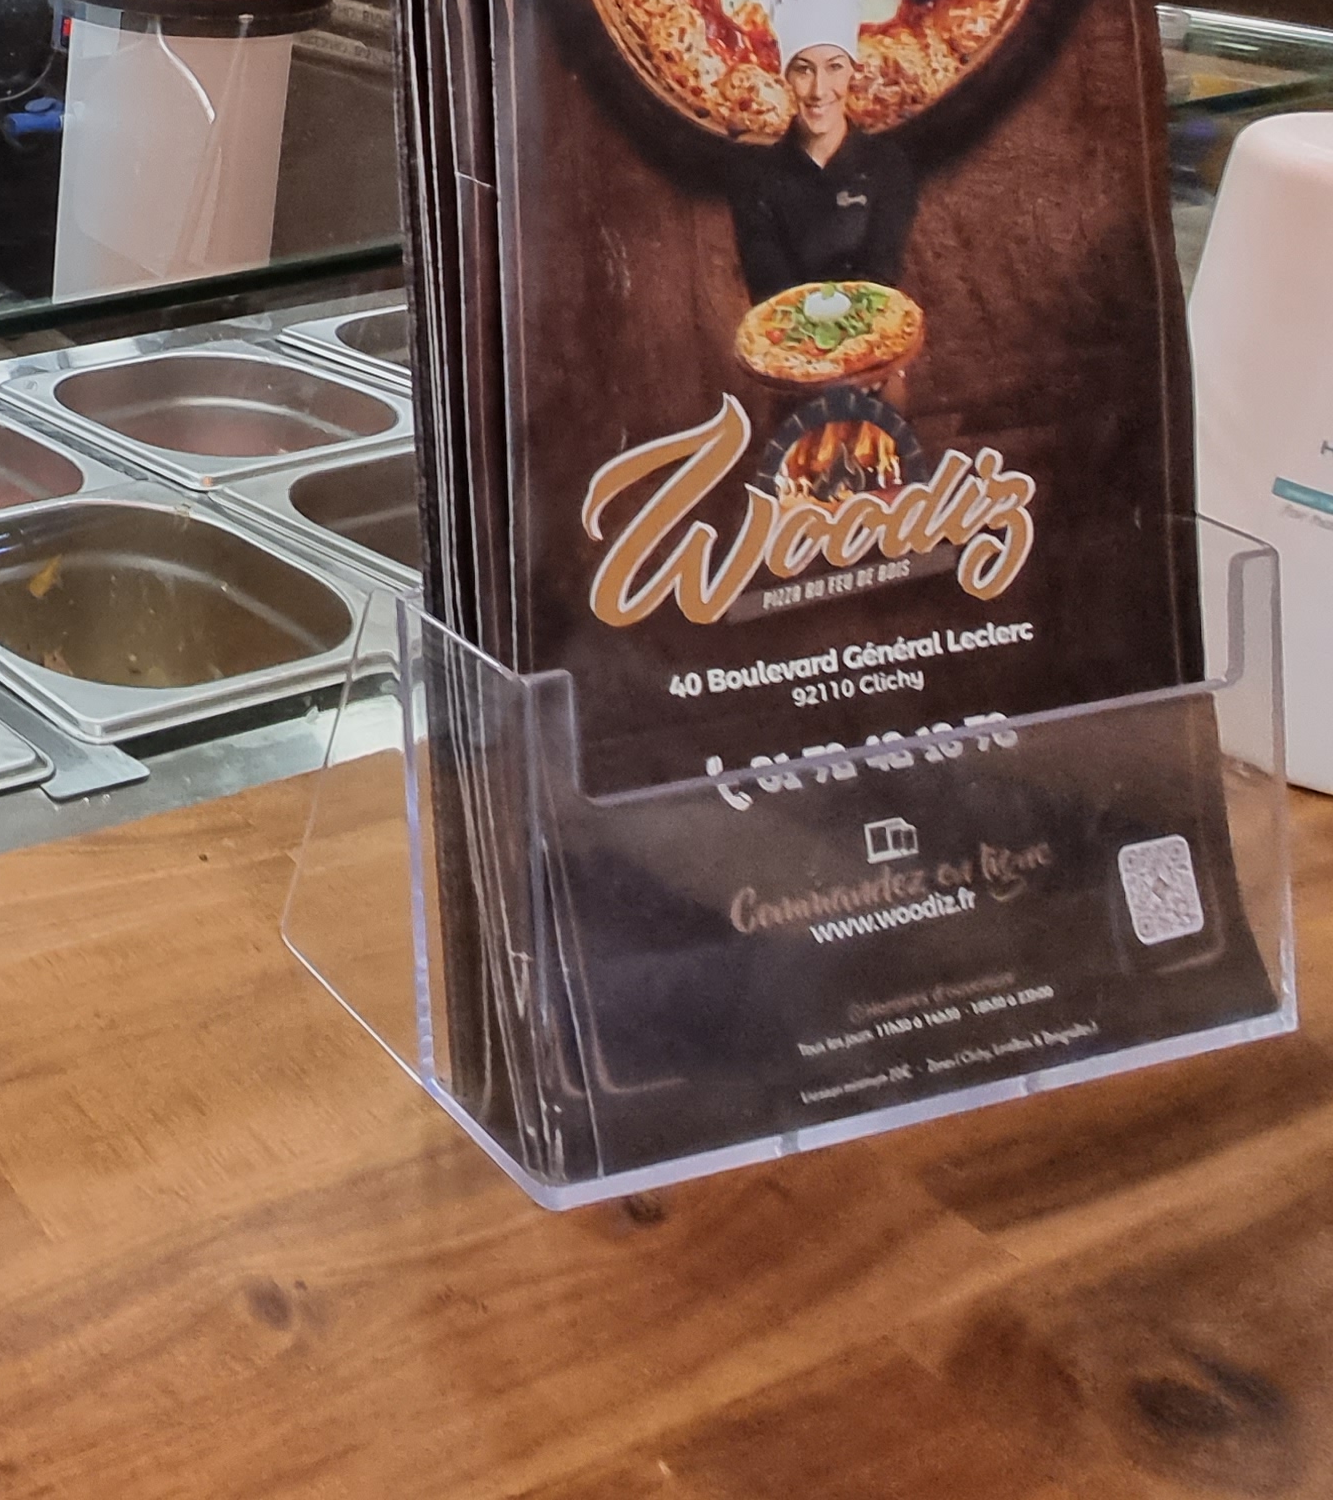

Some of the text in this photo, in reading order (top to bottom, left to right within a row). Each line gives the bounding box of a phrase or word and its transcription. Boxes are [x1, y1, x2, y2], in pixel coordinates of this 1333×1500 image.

[582, 392, 1037, 627] Woodiz
[828, 572, 854, 594] FEU
[877, 559, 911, 582] BOIS
[669, 621, 1034, 698] 40 Boulevard Général Leclerc
[791, 669, 925, 708] 92110 Clichy
[809, 886, 976, 944] www.woodiz.fr
